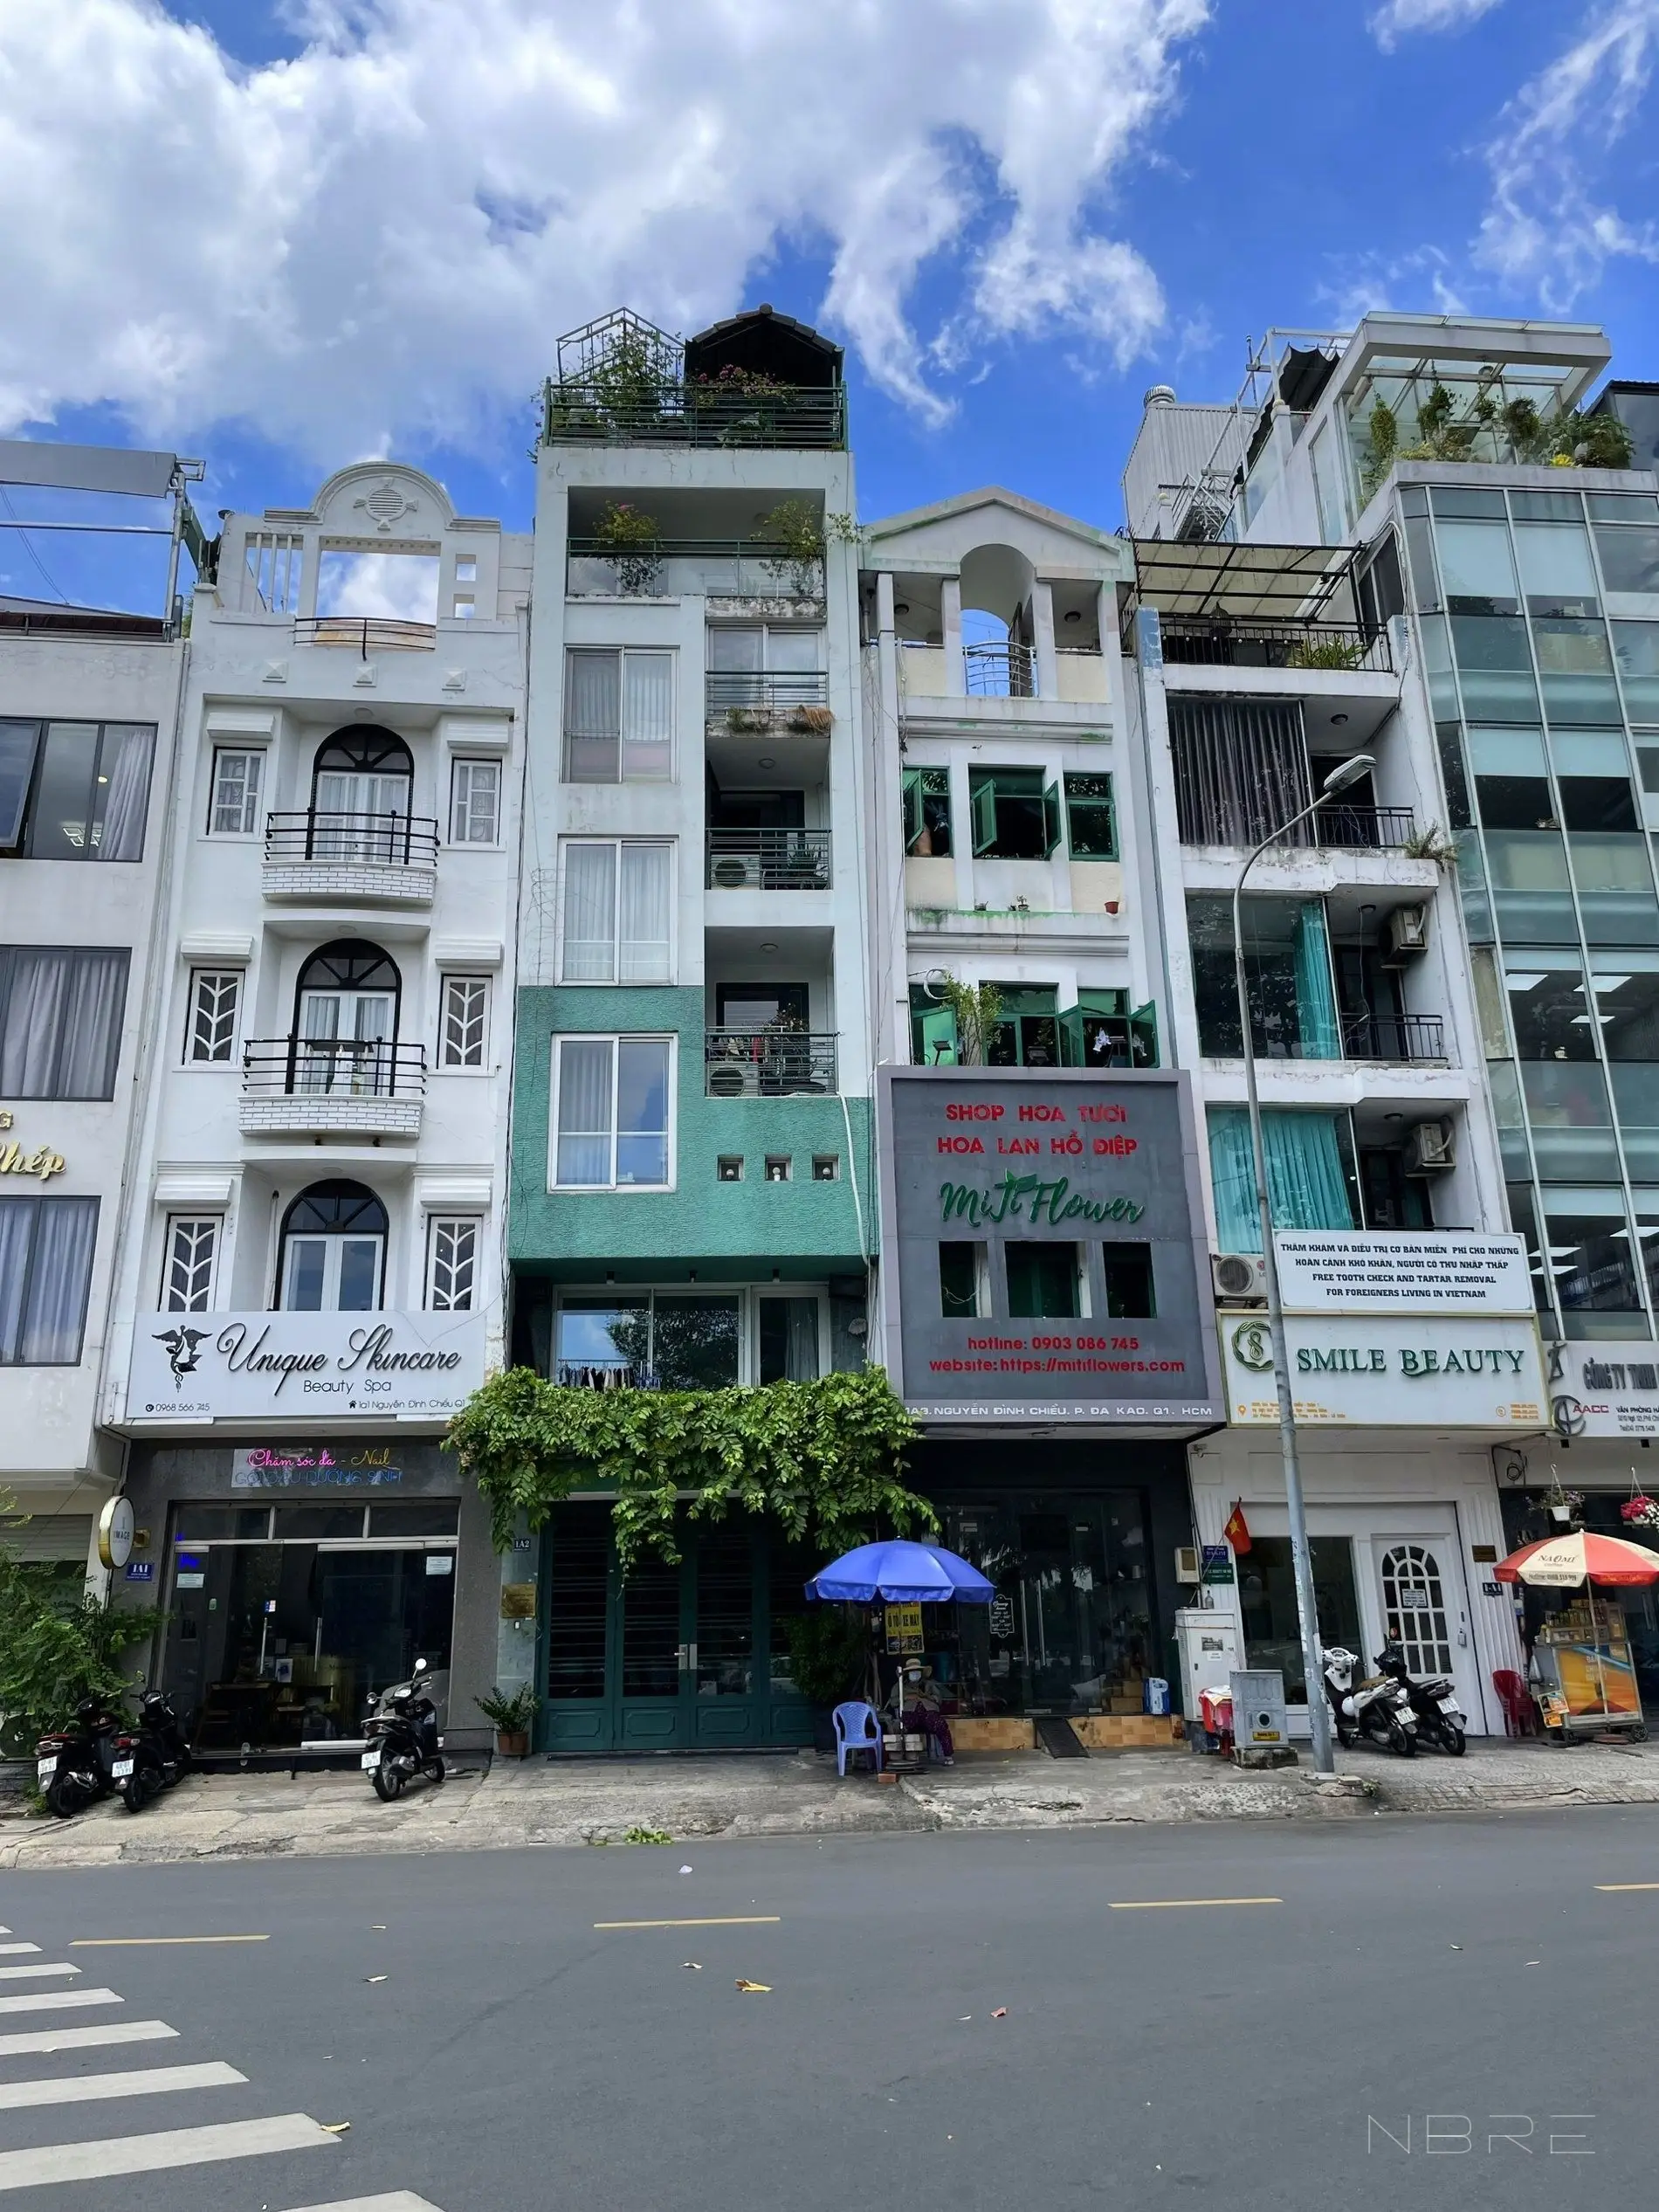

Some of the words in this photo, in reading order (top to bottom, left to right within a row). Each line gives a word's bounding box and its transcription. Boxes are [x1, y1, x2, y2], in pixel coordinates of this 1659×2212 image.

[946, 1104, 1004, 1121] SHOP
[1018, 1105, 1066, 1122] HOA
[1077, 1103, 1127, 1122] TƯƠI
[937, 1136, 985, 1154] HOA
[997, 1137, 1040, 1154] LAN
[1050, 1129, 1084, 1154] HỒ
[1092, 1134, 1138, 1160] ĐIỆP
[0, 1141, 66, 1181] hép
[1028, 1176, 1146, 1224] Flower
[1439, 1260, 1457, 1269] THU
[1312, 1273, 1334, 1282] FREE
[1397, 1274, 1415, 1283] AND
[1346, 1288, 1400, 1297] FOREIGNERS
[1401, 1289, 1431, 1298] LIVING
[1445, 1290, 1486, 1299] VIETNAM
[967, 1337, 1027, 1350] hotline:
[1032, 1337, 1072, 1350] 0903
[1076, 1337, 1106, 1350] 086
[1111, 1337, 1139, 1350] 745
[217, 1322, 328, 1396] Unique
[337, 1323, 462, 1371] Skincare
[930, 1360, 998, 1372] website:
[1297, 1348, 1387, 1373] SMILE
[1397, 1349, 1525, 1377] BEAUTY
[304, 1380, 354, 1395] Beauty
[364, 1379, 392, 1394] Spa
[155, 1402, 176, 1412] 0968
[178, 1402, 194, 1411] 566
[934, 1402, 988, 1416] NGUYỄN
[993, 1403, 1025, 1415] ĐÌNH
[1074, 1407, 1085, 1416] P.
[1117, 1407, 1149, 1416] KAO.
[1181, 1407, 1212, 1416] HCM
[1573, 1404, 1609, 1414] AACC
[248, 1449, 294, 1467] Chăm
[296, 1456, 317, 1466] sóc
[351, 1447, 390, 1466] Nail
[515, 1540, 530, 1548] 1A2
